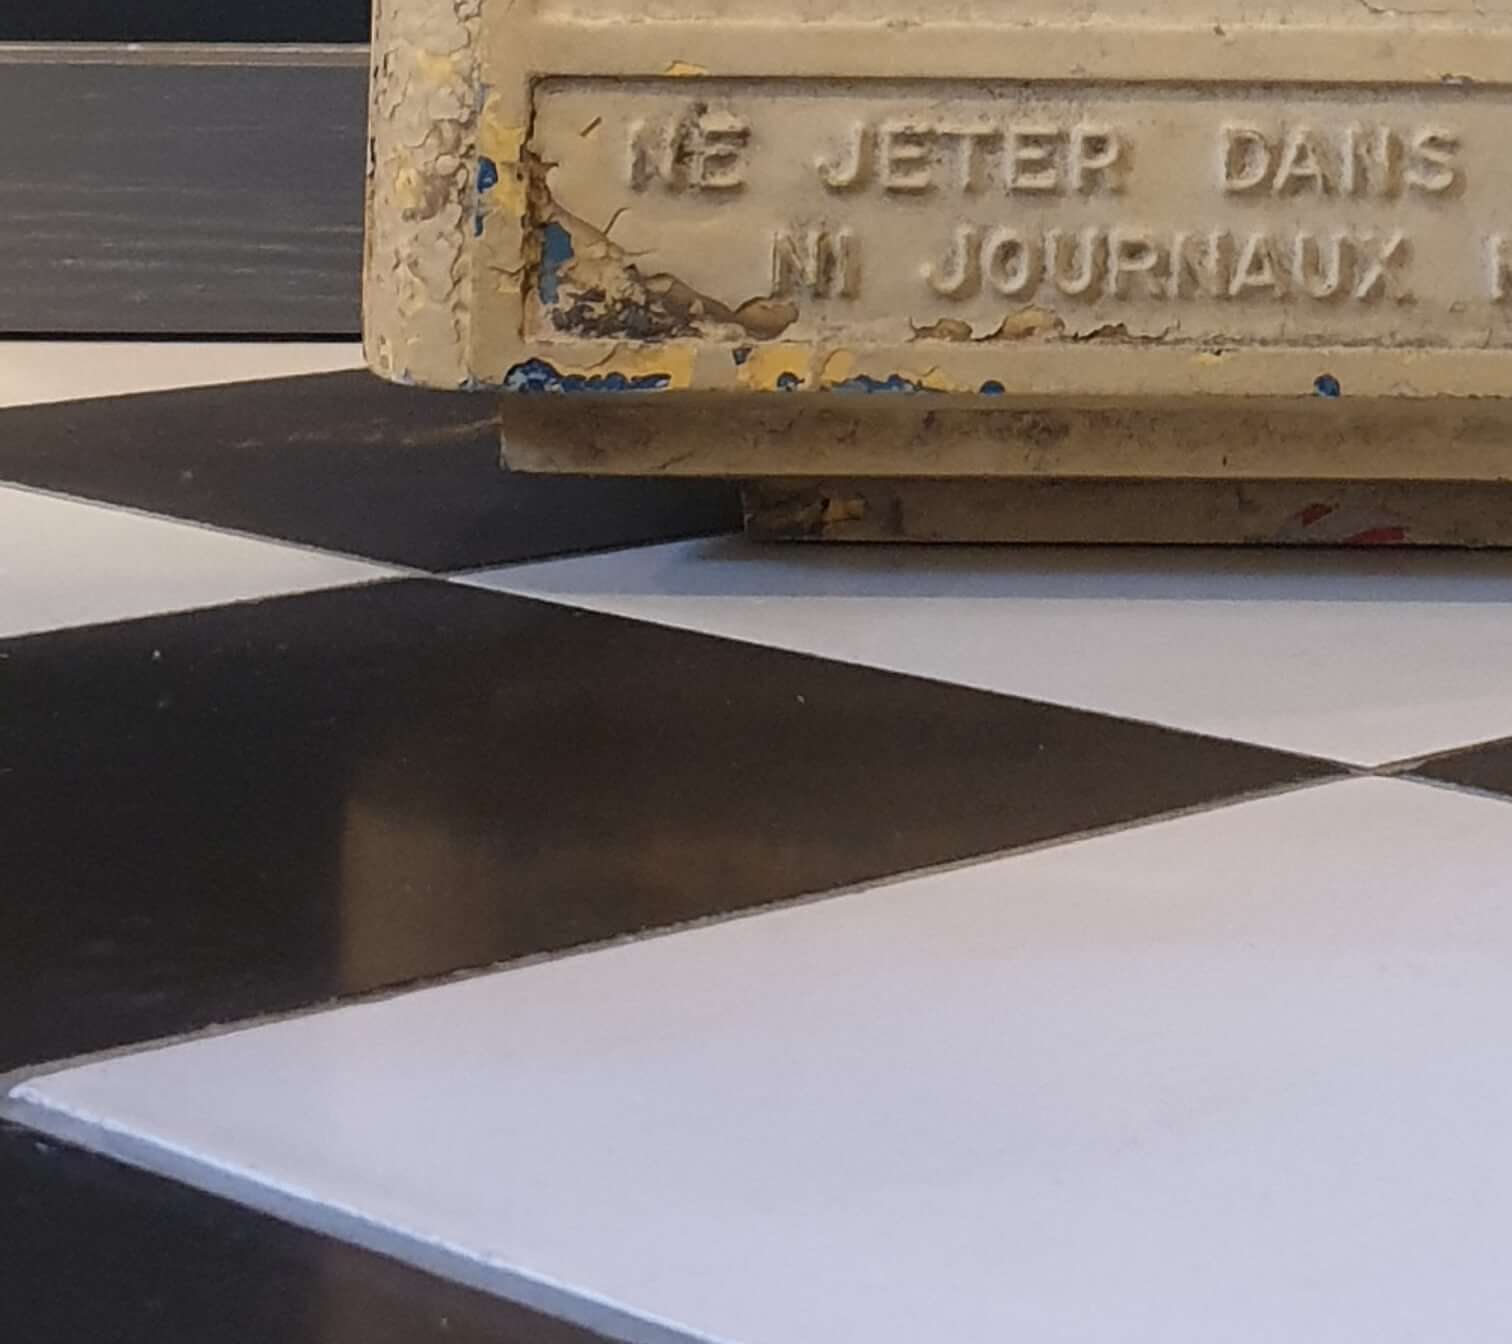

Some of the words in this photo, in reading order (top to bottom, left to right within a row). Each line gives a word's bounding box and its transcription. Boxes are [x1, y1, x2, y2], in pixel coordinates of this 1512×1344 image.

[624, 108, 752, 193] NE
[815, 118, 1130, 198] JETER
[1218, 119, 1462, 198] DANS
[769, 226, 862, 302] NI
[917, 224, 1418, 306] JOURNAUX
